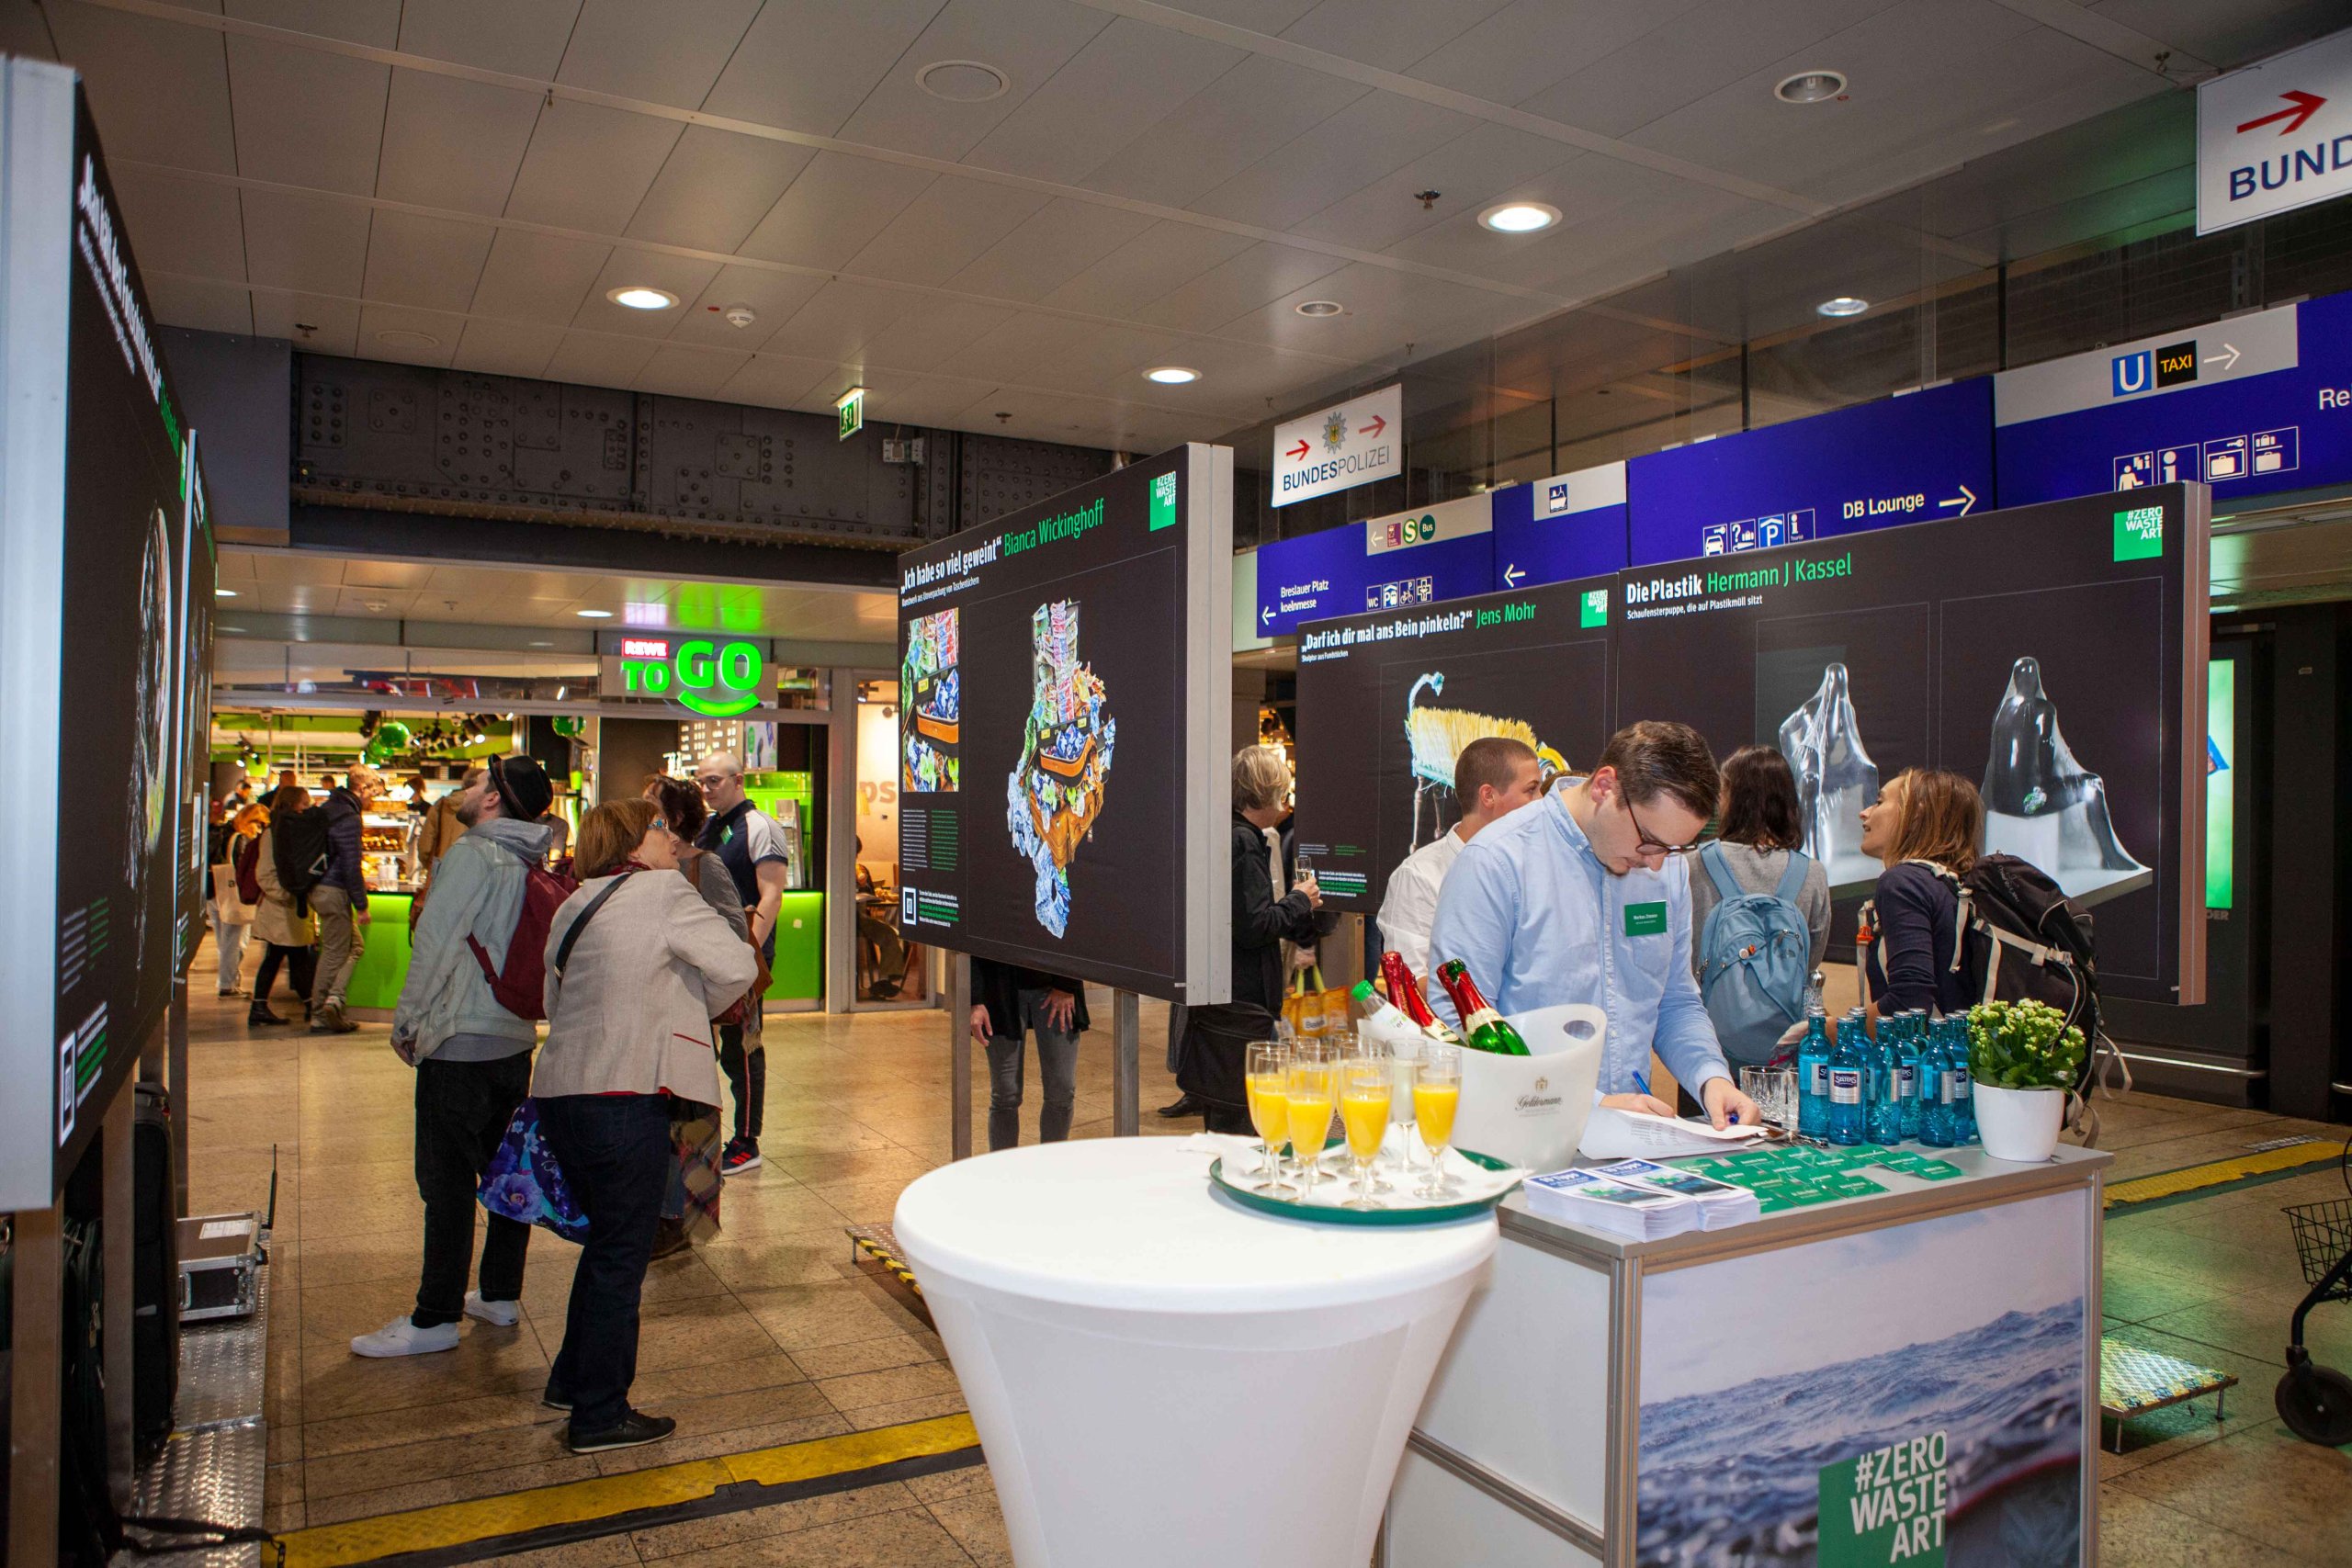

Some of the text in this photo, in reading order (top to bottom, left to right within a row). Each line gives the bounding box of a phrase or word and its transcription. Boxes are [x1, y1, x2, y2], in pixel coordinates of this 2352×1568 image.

[2161, 354, 2193, 374] TAXI
[1283, 446, 1390, 491] BUNDESPOLIZEI
[1157, 470, 1177, 487] #ZERO
[1156, 482, 1177, 499] WASTE
[1163, 493, 1177, 508] ART
[1843, 493, 1925, 520] DB Lounge
[2127, 505, 2164, 521] #ZERO
[1421, 523, 1433, 533] Bus
[2125, 516, 2164, 532] WASTE
[2140, 527, 2163, 540] ART
[917, 561, 935, 585] habe
[935, 564, 945, 579] so
[946, 553, 962, 575] viel
[963, 535, 1002, 575] geweint“
[1004, 529, 1036, 557] Bianca
[1038, 497, 1105, 542] Wickinghoff
[1626, 582, 1649, 604] Die
[1651, 574, 1702, 601] Plastik
[1707, 568, 1779, 593] Hermann
[1794, 552, 1852, 581] Kassel
[1281, 580, 1329, 598] Breslauer Platz
[1281, 598, 1317, 613] koelnmesse
[1367, 597, 1379, 608] WC
[1626, 594, 1763, 620] Schaufensterpuppe, die auf Plastikmüll sitzt
[1301, 602, 1537, 652] „Darf ich dir mal ans Bein pinkeln?“ Jens Mohr
[624, 640, 667, 657] REWE
[621, 639, 763, 693] TO GO
[1855, 1430, 1947, 1493] #ZERO
[1850, 1469, 1947, 1535] WASTE
[1889, 1509, 1946, 1563] ART
